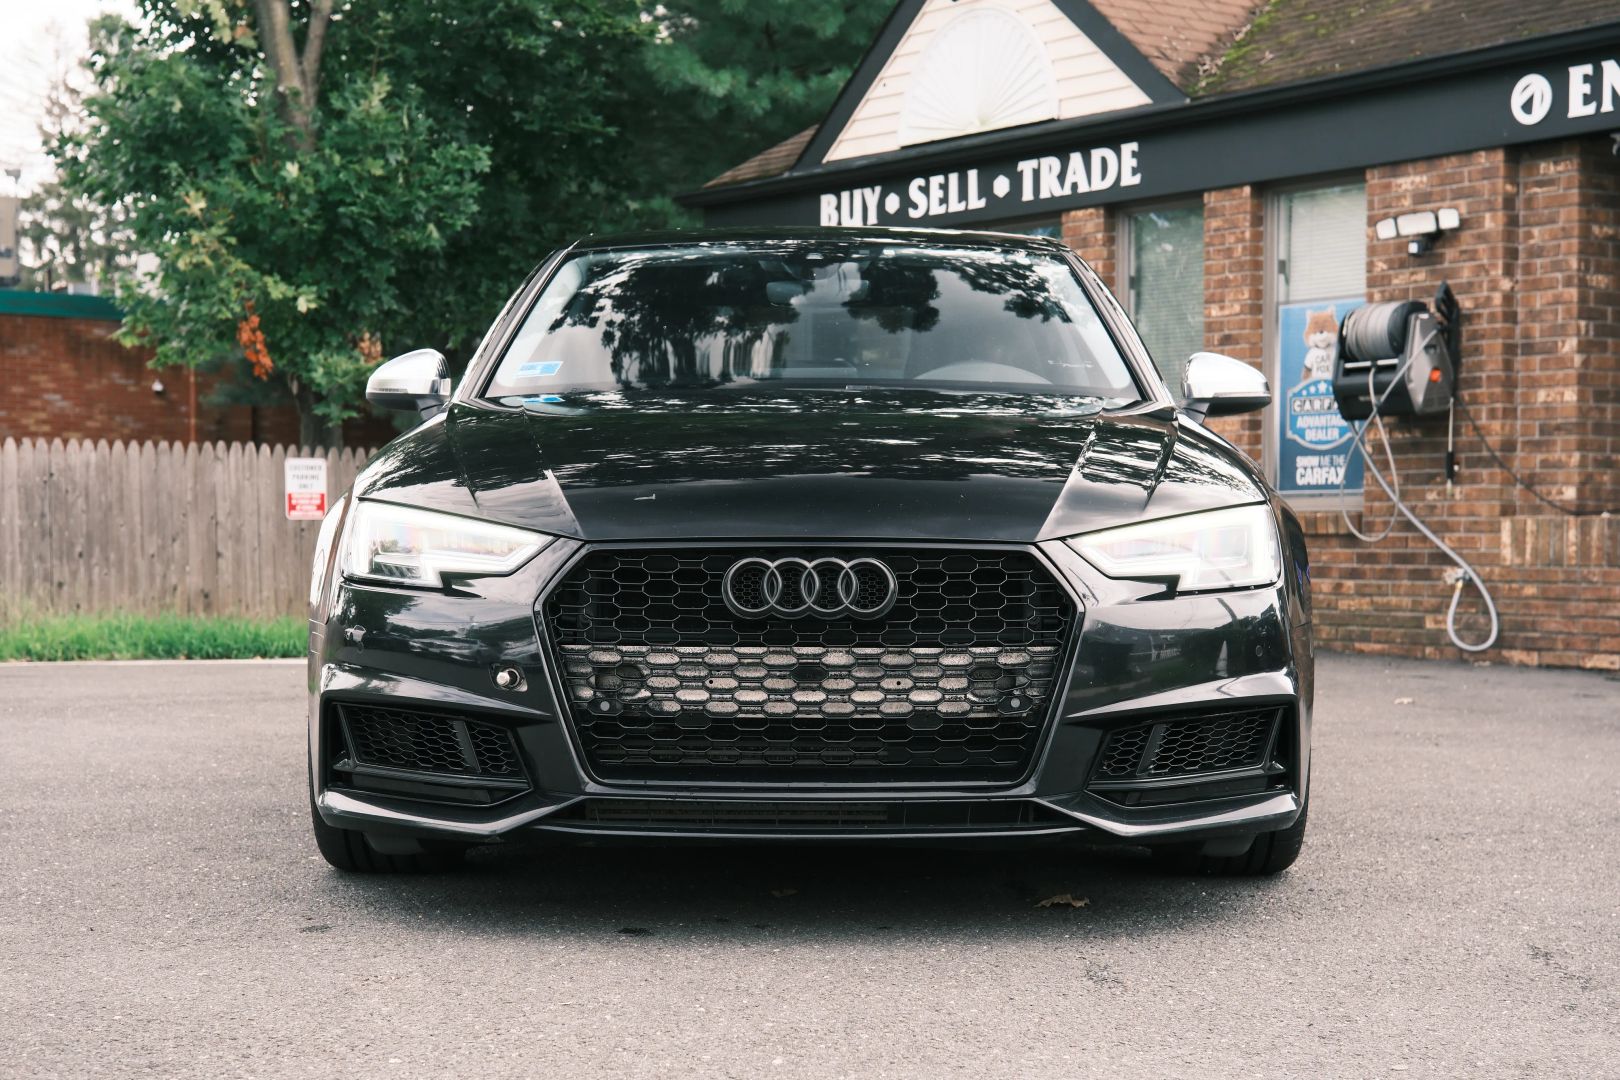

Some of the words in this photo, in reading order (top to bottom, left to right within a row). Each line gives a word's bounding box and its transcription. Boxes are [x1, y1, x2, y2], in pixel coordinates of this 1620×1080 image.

[820, 186, 881, 226] BUY
[908, 169, 986, 218] SELL
[1017, 142, 1141, 201] TRADE
[1293, 399, 1338, 412] CARFA
[1305, 428, 1339, 441] DEALER
[1296, 466, 1346, 485] CARFAX
